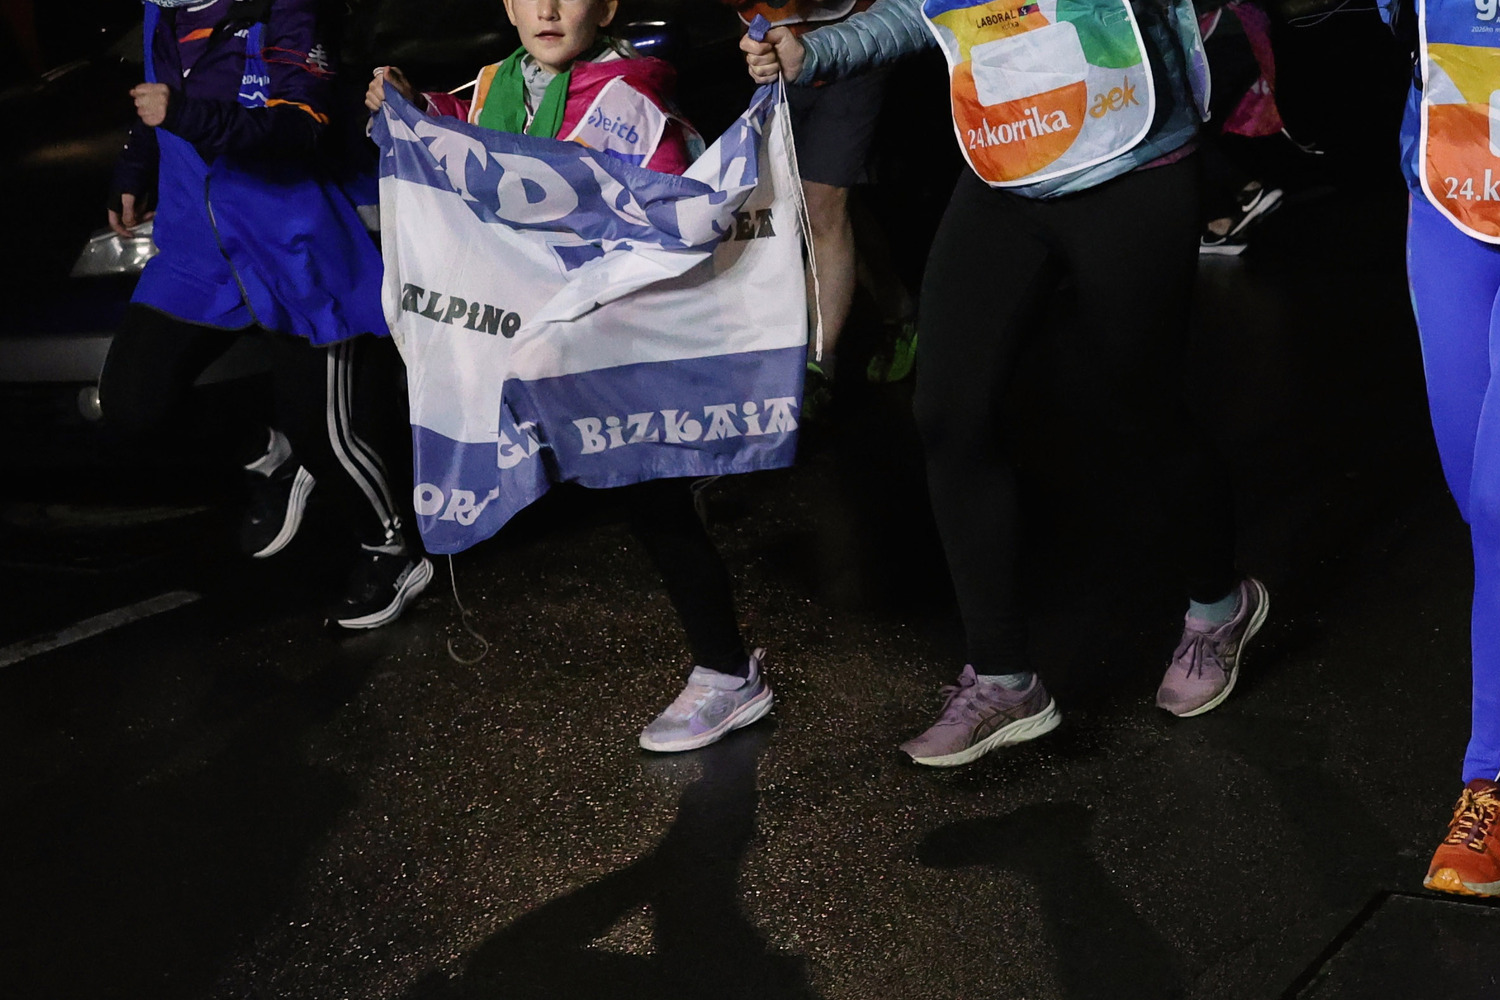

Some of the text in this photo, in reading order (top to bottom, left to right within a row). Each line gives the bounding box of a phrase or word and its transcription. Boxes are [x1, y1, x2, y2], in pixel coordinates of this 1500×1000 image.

[976, 10, 1017, 29] LABORAL
[1089, 75, 1139, 119] aek
[603, 116, 639, 144] eitb
[967, 106, 1072, 150] 24.korrika
